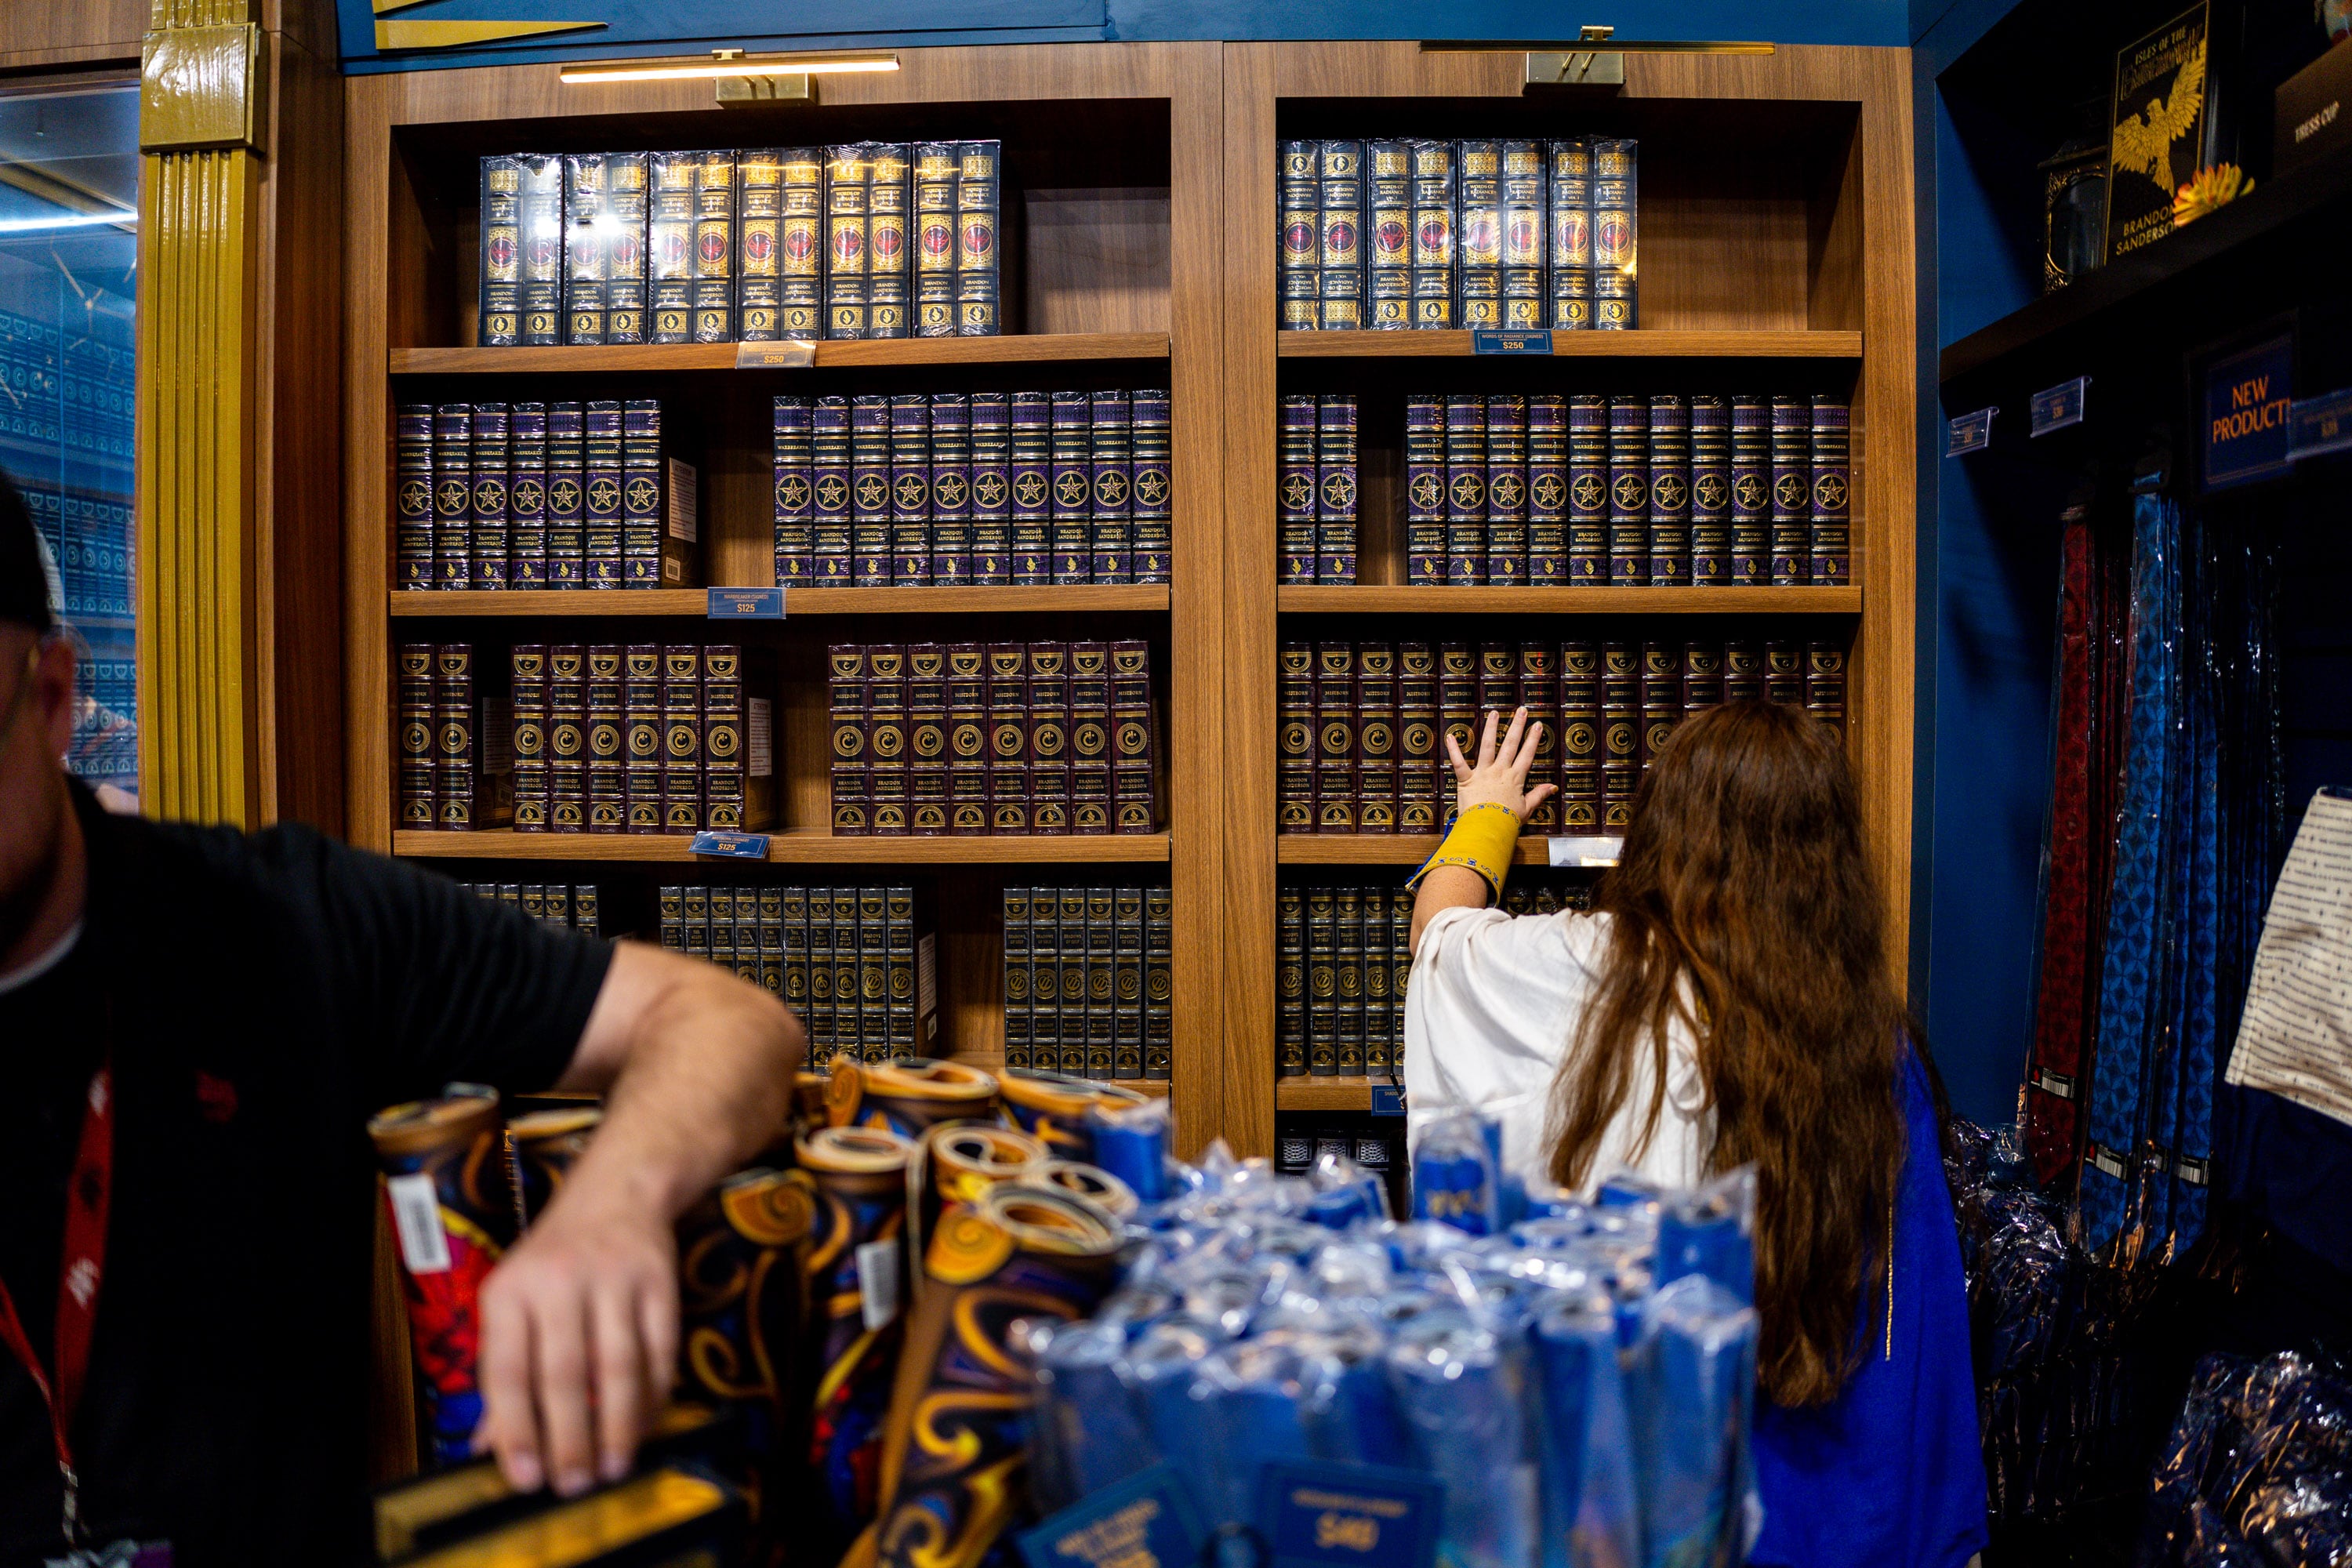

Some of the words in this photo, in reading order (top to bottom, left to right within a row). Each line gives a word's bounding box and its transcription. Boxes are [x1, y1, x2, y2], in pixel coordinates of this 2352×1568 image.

[2135, 43, 2157, 66] ISLES
[2158, 37, 2169, 52] OF
[2171, 25, 2187, 44] THE
[2295, 112, 2321, 144] TRESS
[2321, 100, 2340, 126] CUP
[2115, 220, 2175, 256] SANDERSO
[764, 355, 784, 364] $250
[1503, 341, 1524, 350] $250
[2231, 374, 2270, 410] NEW
[737, 604, 755, 613] $125
